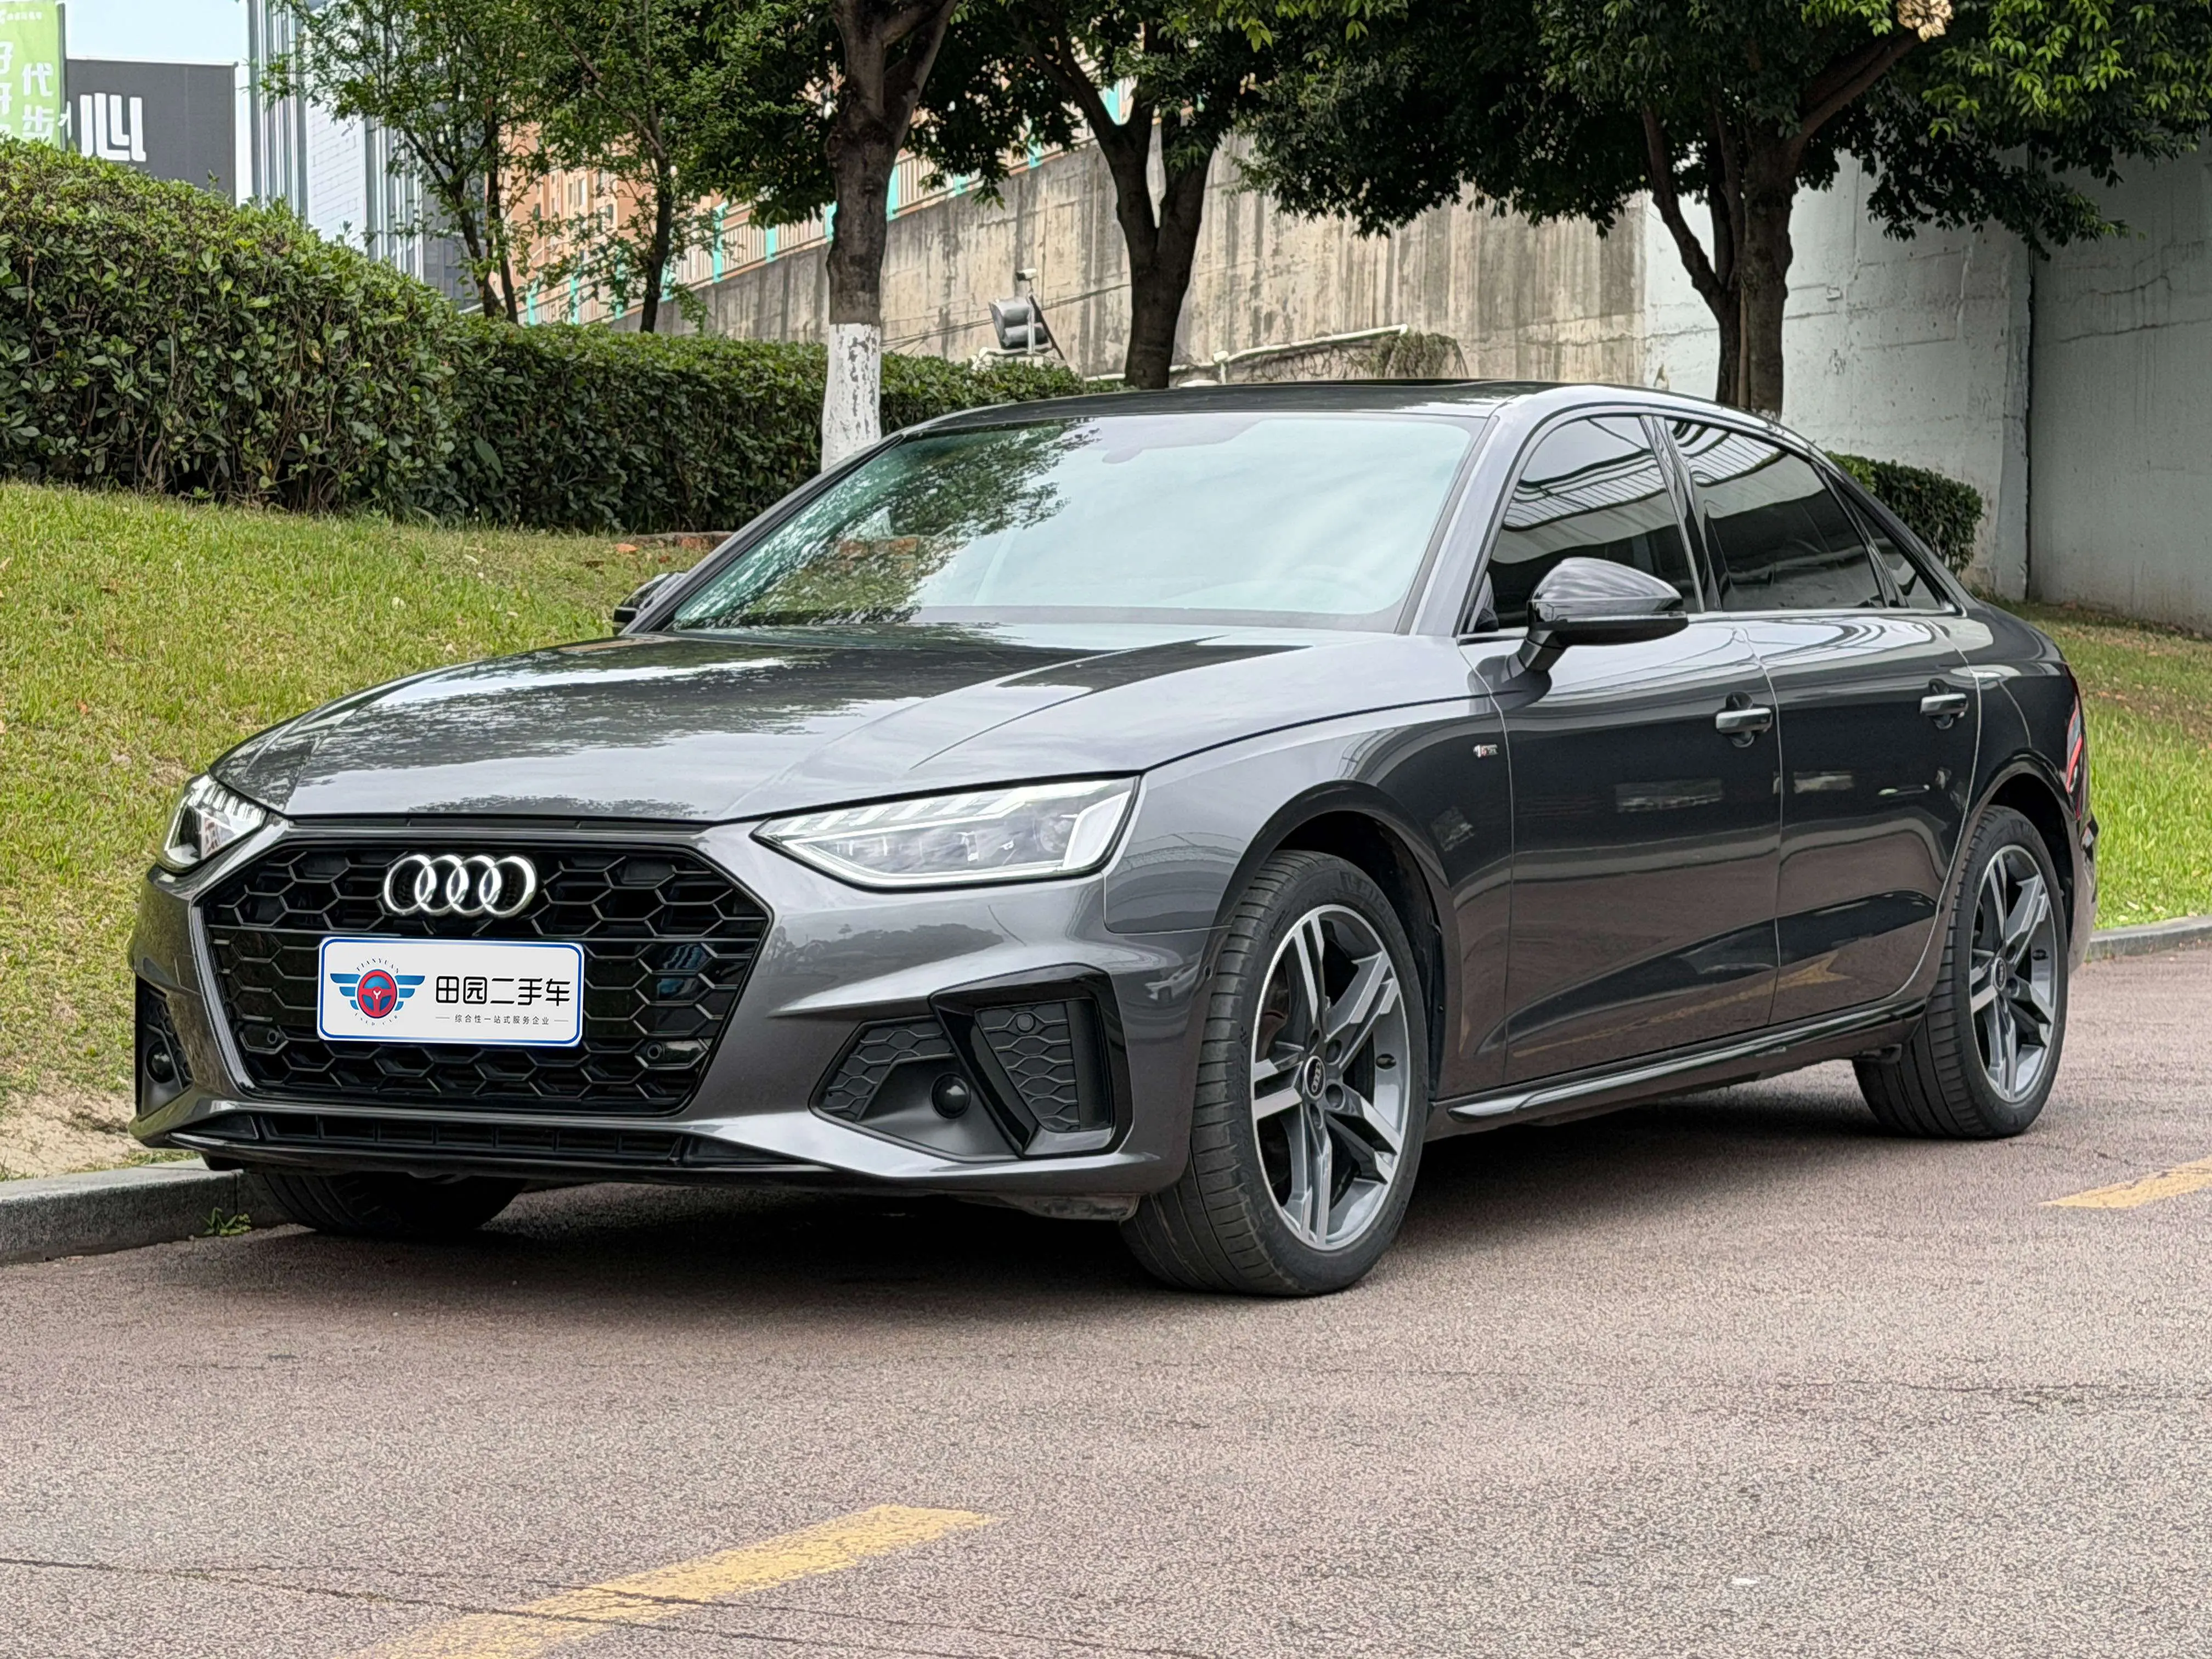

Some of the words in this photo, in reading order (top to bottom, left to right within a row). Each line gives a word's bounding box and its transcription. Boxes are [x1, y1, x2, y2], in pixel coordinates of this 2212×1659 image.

[436, 975, 571, 1007] 田园二手车
[455, 1014, 549, 1025] 综合性一站式服务企业
